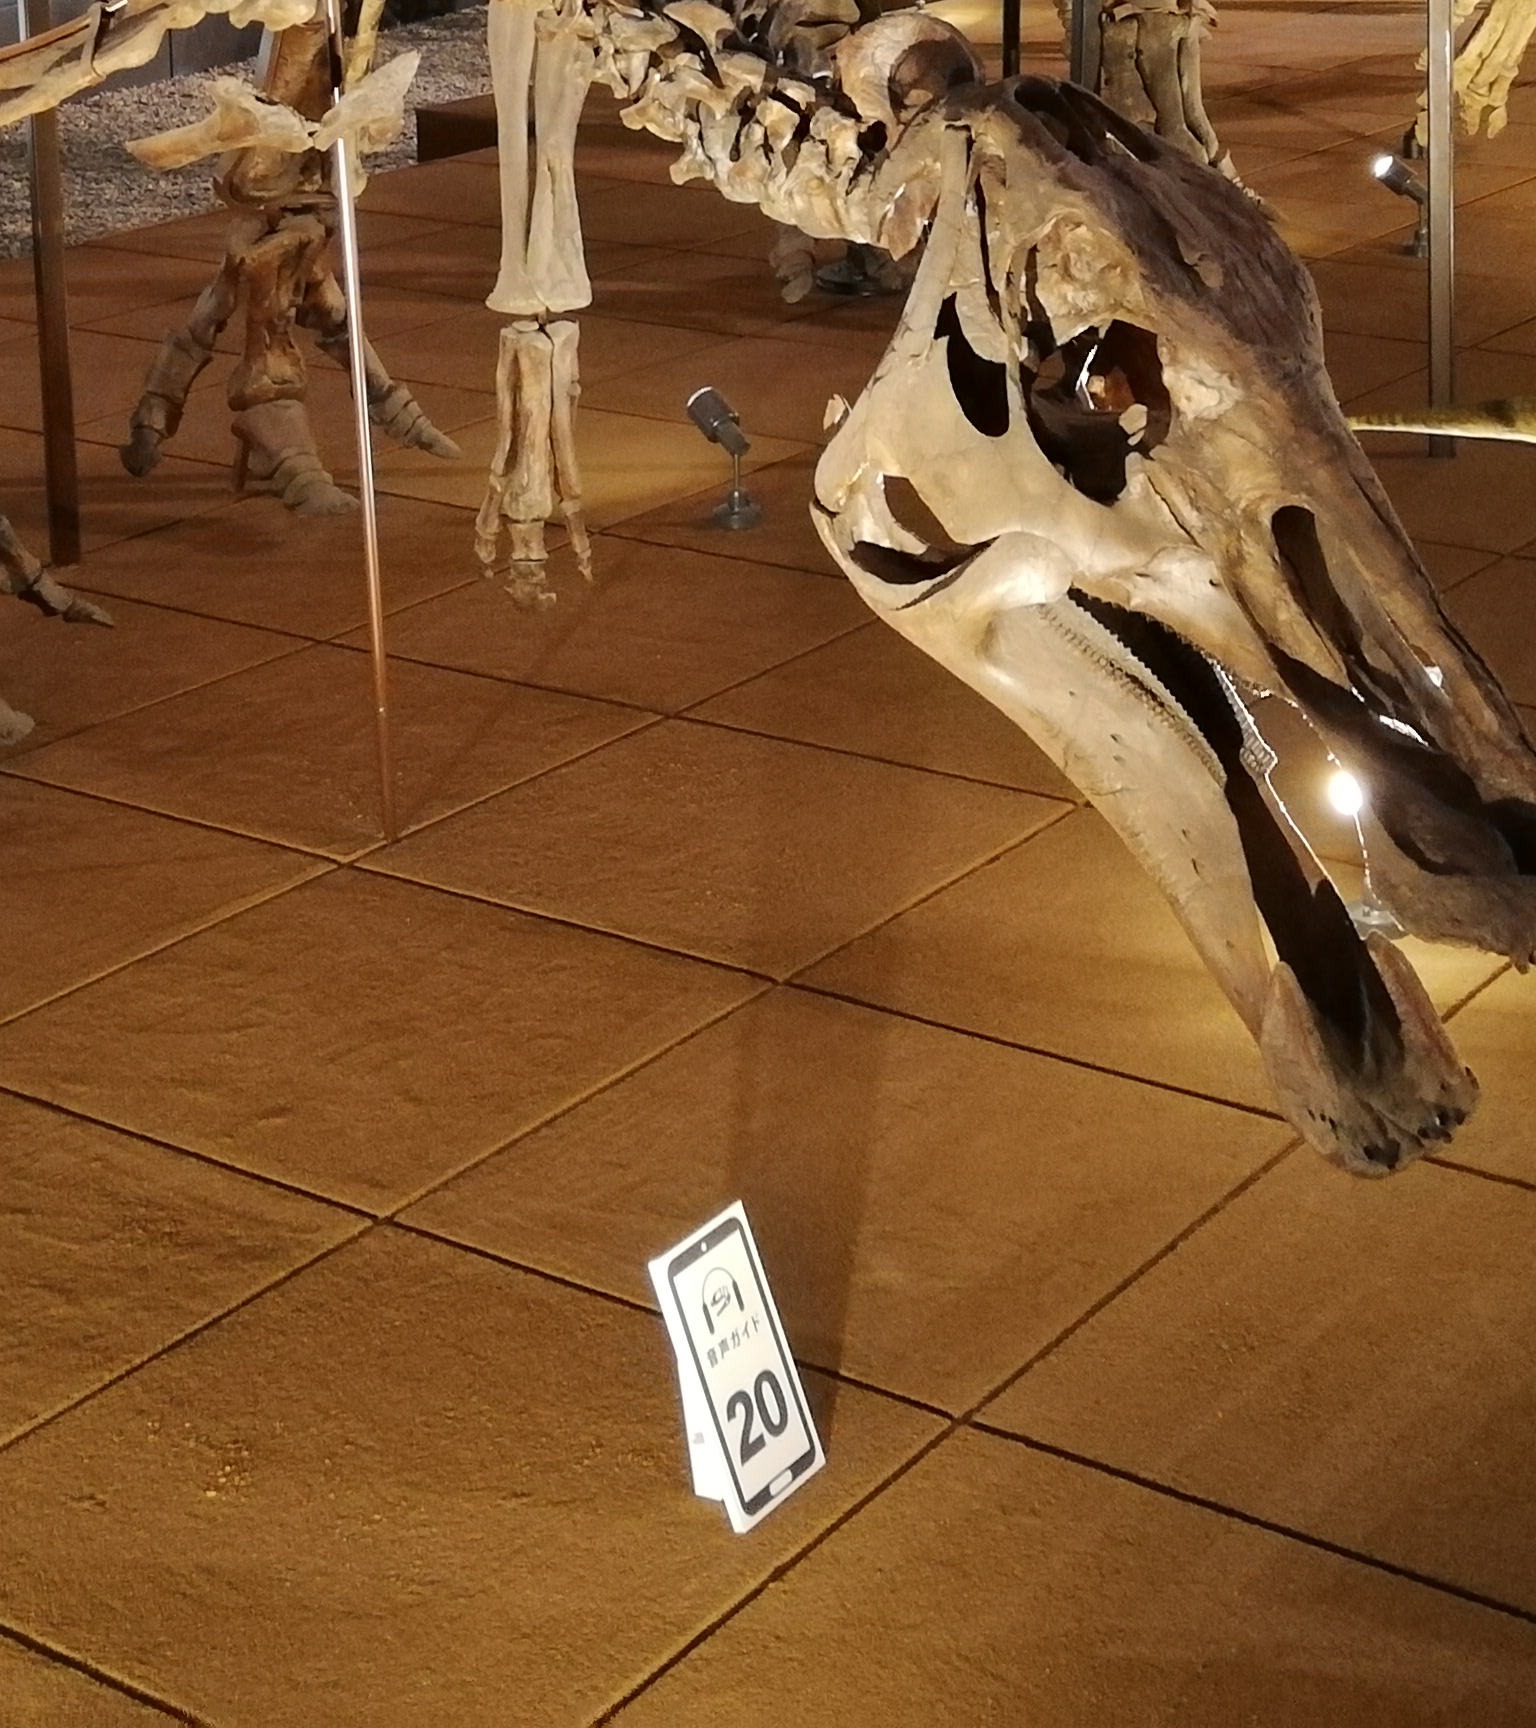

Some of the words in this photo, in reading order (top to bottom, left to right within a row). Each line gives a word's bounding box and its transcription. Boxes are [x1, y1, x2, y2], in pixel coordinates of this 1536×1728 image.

[707, 1314, 761, 1368] 音声ガイド
[726, 1369, 788, 1467] 20
